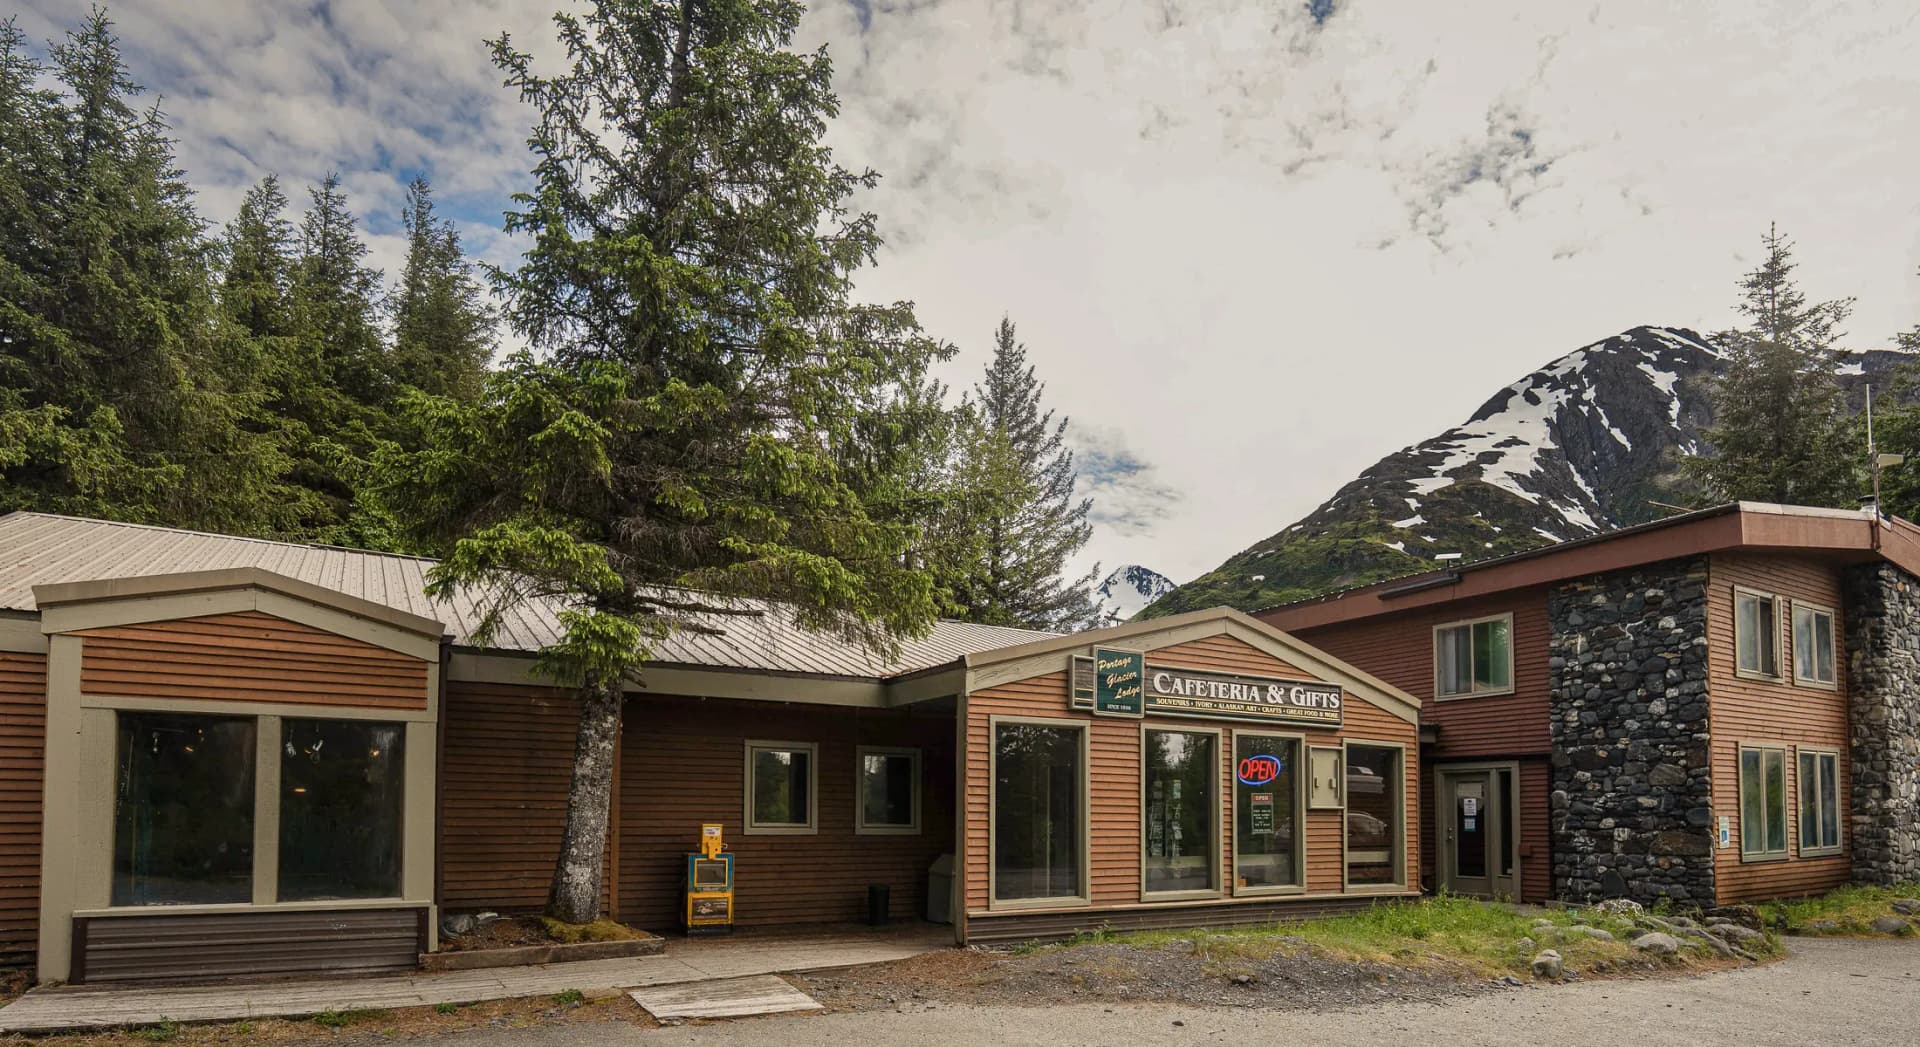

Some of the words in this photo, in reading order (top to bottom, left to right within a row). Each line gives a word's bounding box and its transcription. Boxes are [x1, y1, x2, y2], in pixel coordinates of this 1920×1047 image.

[1098, 656, 1132, 671] Portage
[1106, 671, 1137, 688] Glacier
[1114, 685, 1141, 699] Lodge
[1153, 672, 1260, 702] CAFETERIA
[1266, 684, 1285, 704] &
[1290, 686, 1340, 709] GIFTS
[1156, 698, 1190, 707] SOUVENIRS
[1195, 700, 1213, 708] IVORY
[1218, 702, 1245, 711] ALASKAN
[1246, 704, 1257, 712] ART
[1262, 706, 1282, 714] CRAFTS
[1286, 708, 1303, 716] GREAT
[1325, 711, 1338, 719] MORE
[1238, 758, 1277, 781] OPEN
